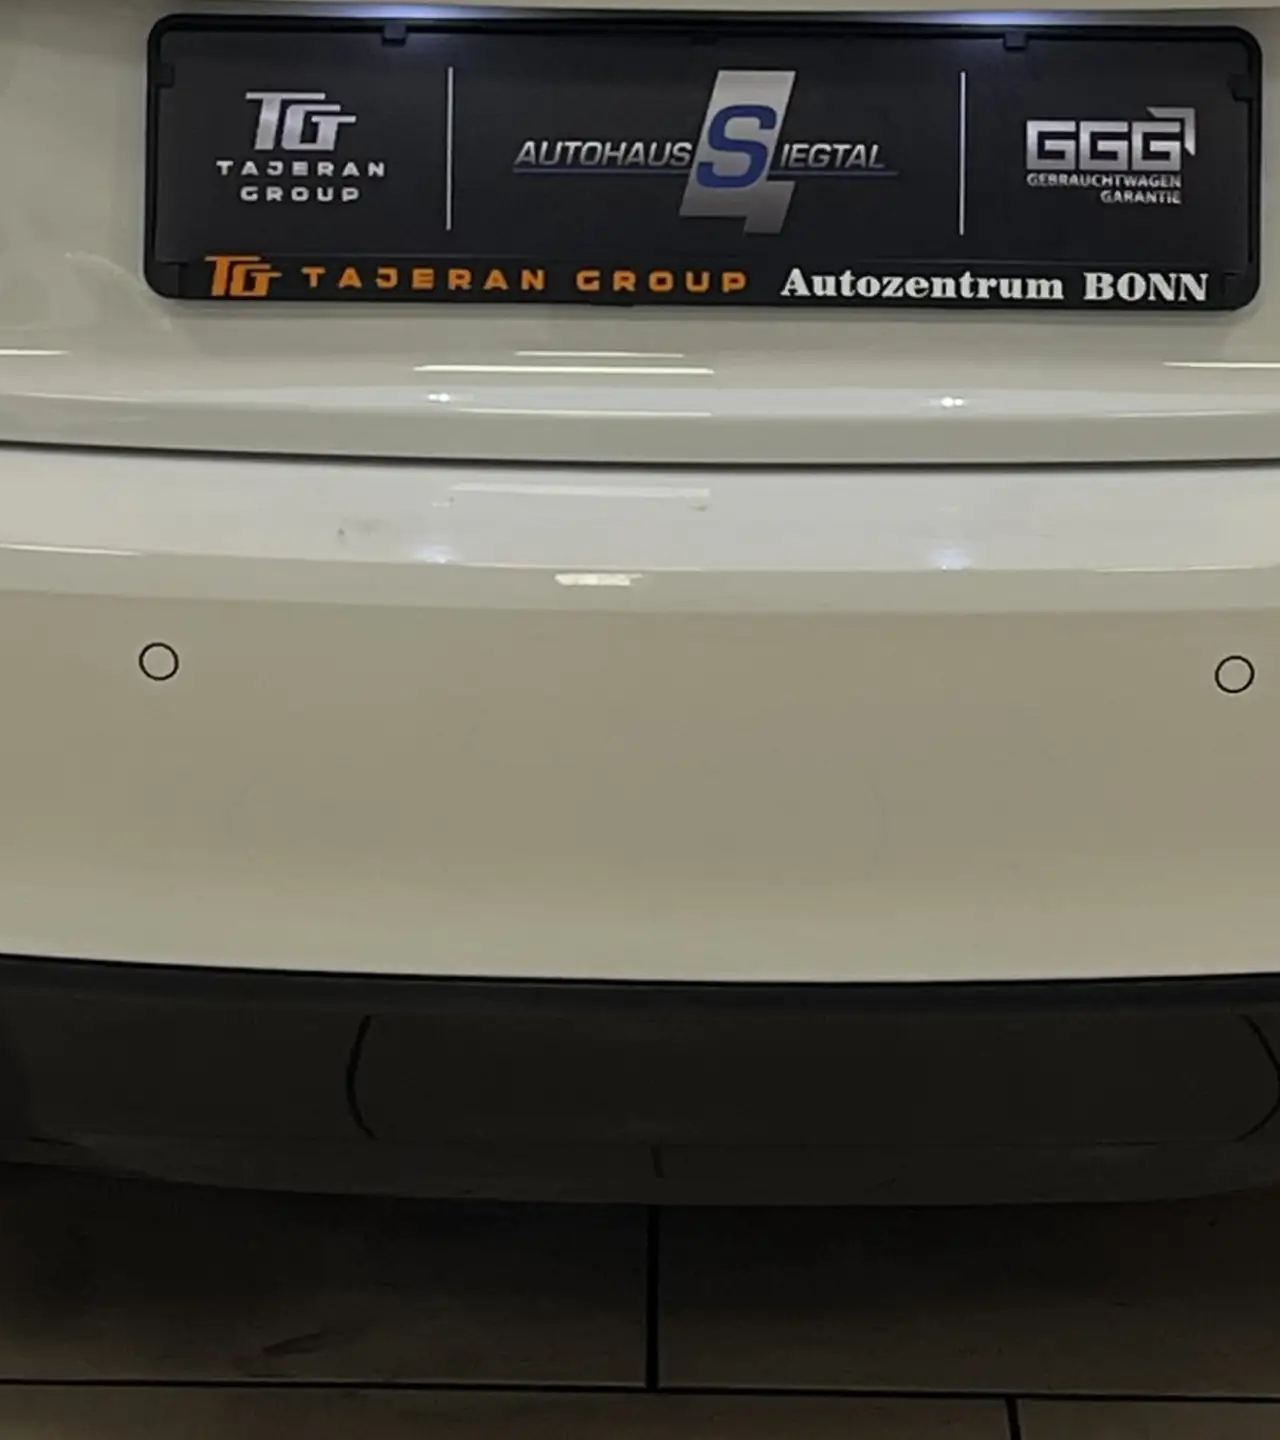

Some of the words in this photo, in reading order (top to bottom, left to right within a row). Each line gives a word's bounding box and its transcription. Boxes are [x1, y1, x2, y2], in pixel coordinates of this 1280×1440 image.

[516, 140, 693, 167] AUTOHAUS
[1026, 120, 1182, 172] GGG
[215, 160, 386, 177] TAJERAN
[1026, 172, 1182, 188] GEBRAUCHTWAGEN
[239, 186, 361, 202] GROUP
[1100, 189, 1182, 204] GARANTIE
[301, 266, 545, 291] TAJERAN
[576, 270, 747, 293] GROUP
[780, 267, 1065, 300] Autozentrum
[1083, 271, 1210, 302] BONN
